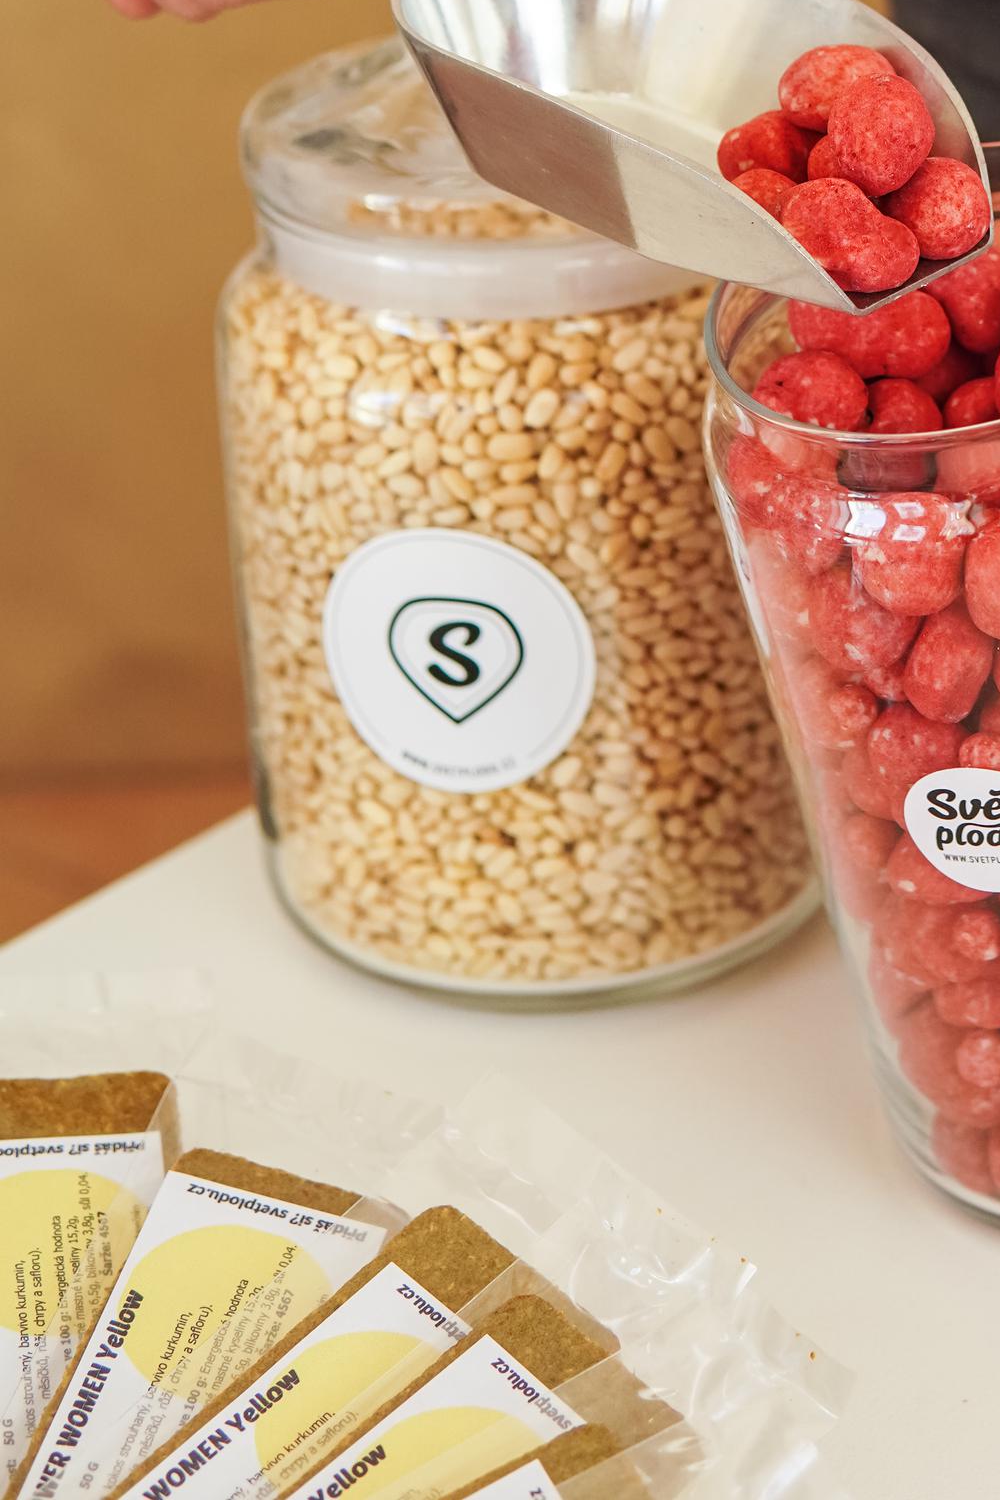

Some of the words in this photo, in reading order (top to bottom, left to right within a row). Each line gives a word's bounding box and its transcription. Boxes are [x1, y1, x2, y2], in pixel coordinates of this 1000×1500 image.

[428, 621, 481, 687] S
[69, 1142, 89, 1155] si?
[186, 1183, 290, 1220] svetplodu.cz
[289, 1213, 314, 1227] si?
[51, 1215, 62, 1254] hodnota
[14, 1260, 27, 1310] kurkumin,
[28, 1247, 43, 1287] safloru).
[275, 1288, 295, 1319] 4567
[18, 1312, 30, 1349] barvivo
[60, 1325, 71, 1345] 100
[160, 1312, 193, 1361] kurkumin,
[188, 1304, 213, 1345] safloru).
[184, 1388, 201, 1412] 100
[224, 1279, 249, 1318] hodnota
[184, 1346, 194, 1355] a
[31, 1451, 71, 1500] WER
[55, 1362, 112, 1447] WOMEN
[95, 1289, 144, 1360] Yellow
[3, 1418, 14, 1428] G
[4, 1431, 15, 1446] 50
[142, 1428, 232, 1500] WOMEN
[225, 1368, 300, 1432] Yellow
[80, 1473, 94, 1490] 50
[88, 1461, 99, 1472] G
